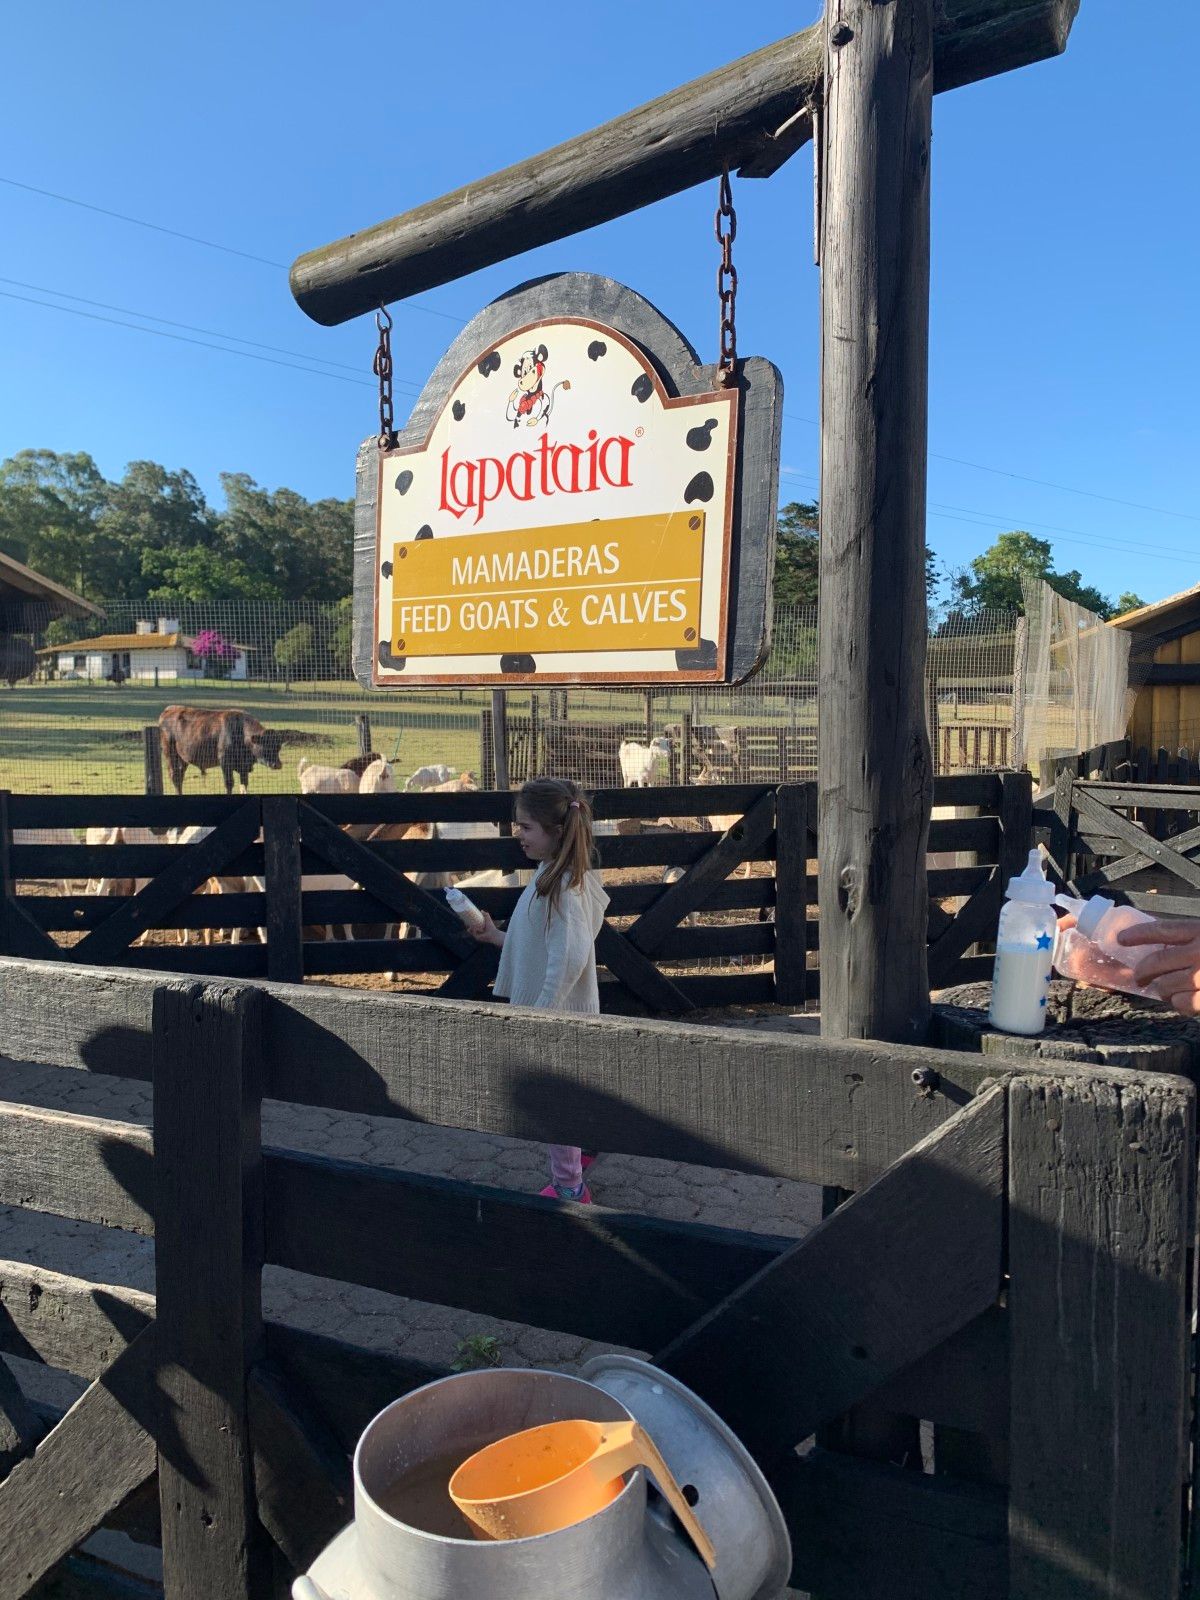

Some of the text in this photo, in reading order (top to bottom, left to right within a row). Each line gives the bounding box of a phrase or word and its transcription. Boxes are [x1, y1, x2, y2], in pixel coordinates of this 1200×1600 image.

[452, 542, 620, 586] MAMADERAS
[400, 588, 688, 634] FEED GOATS & CALVES
